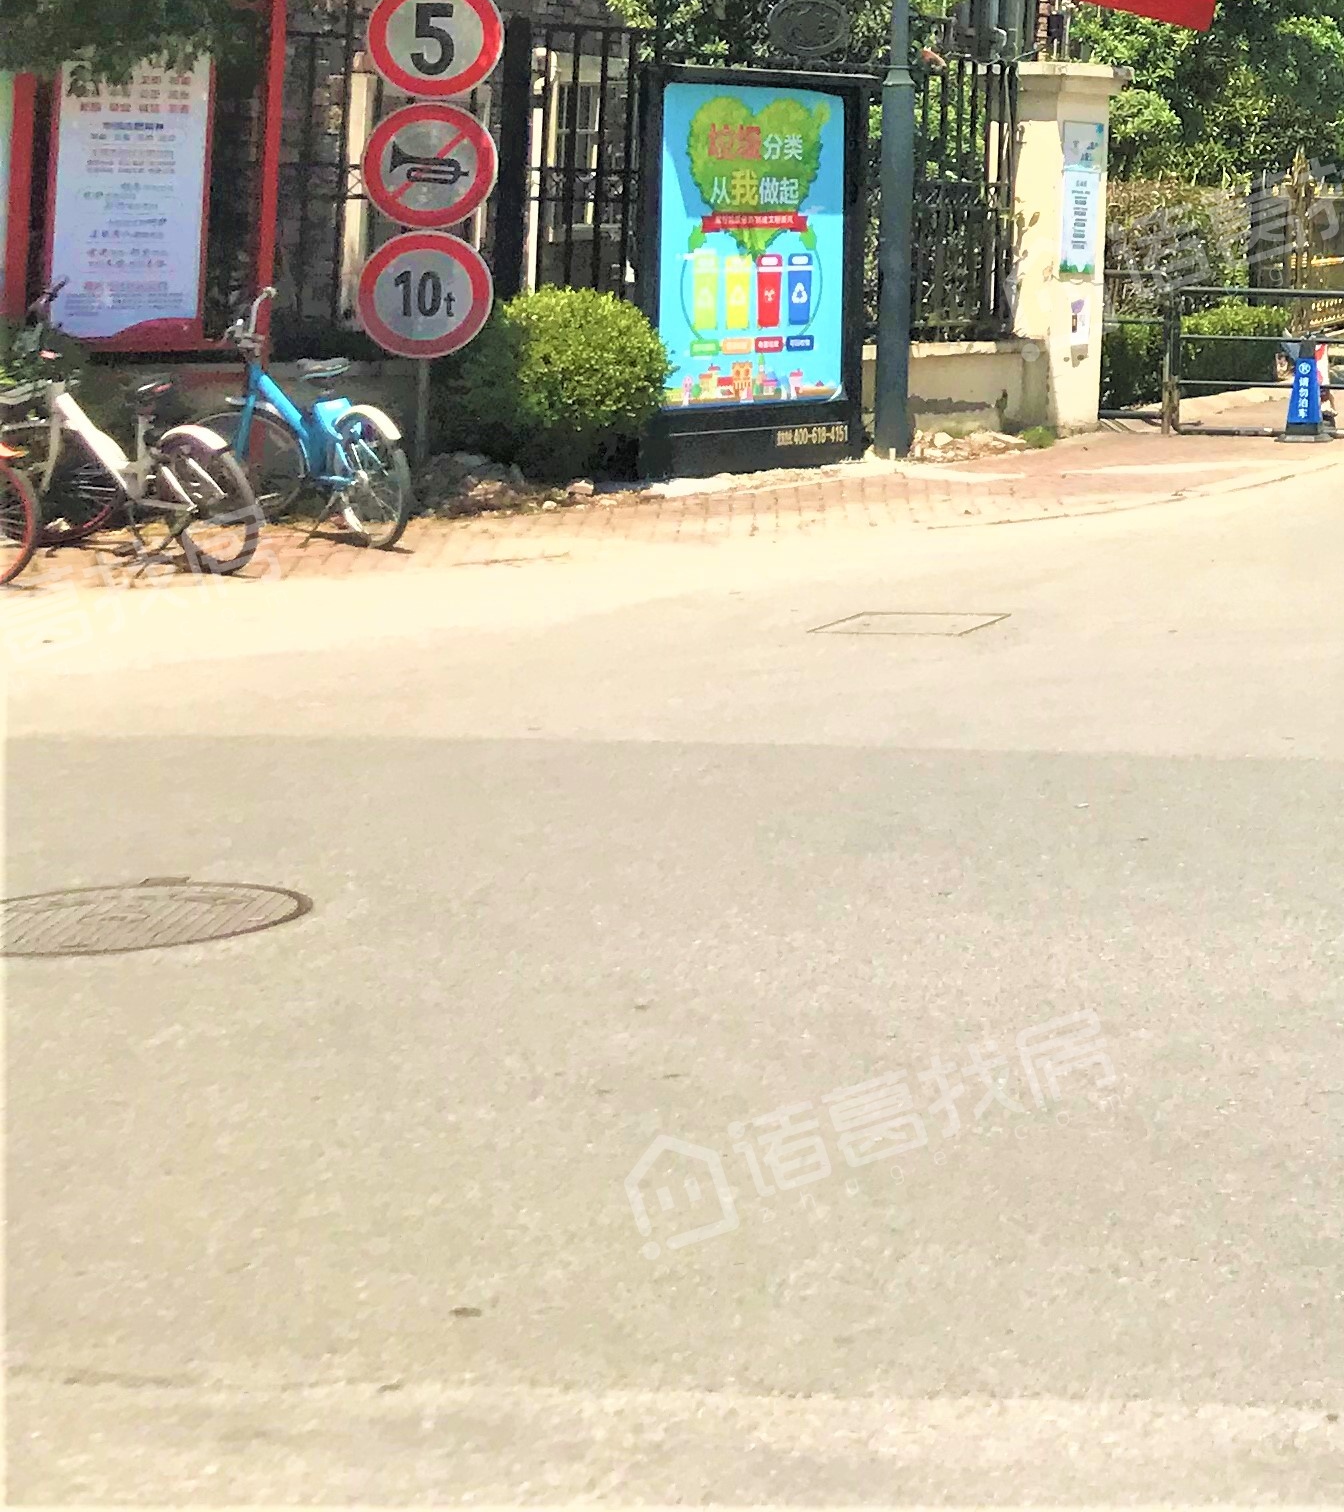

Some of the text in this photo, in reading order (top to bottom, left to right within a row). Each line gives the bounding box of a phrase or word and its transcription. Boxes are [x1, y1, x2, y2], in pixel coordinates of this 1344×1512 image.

[410, 2, 455, 76] 5
[708, 123, 803, 160] 垃圾分类
[710, 168, 799, 206] 从我做起
[394, 271, 455, 318] 10t
[1298, 377, 1309, 418] 请勿泊车
